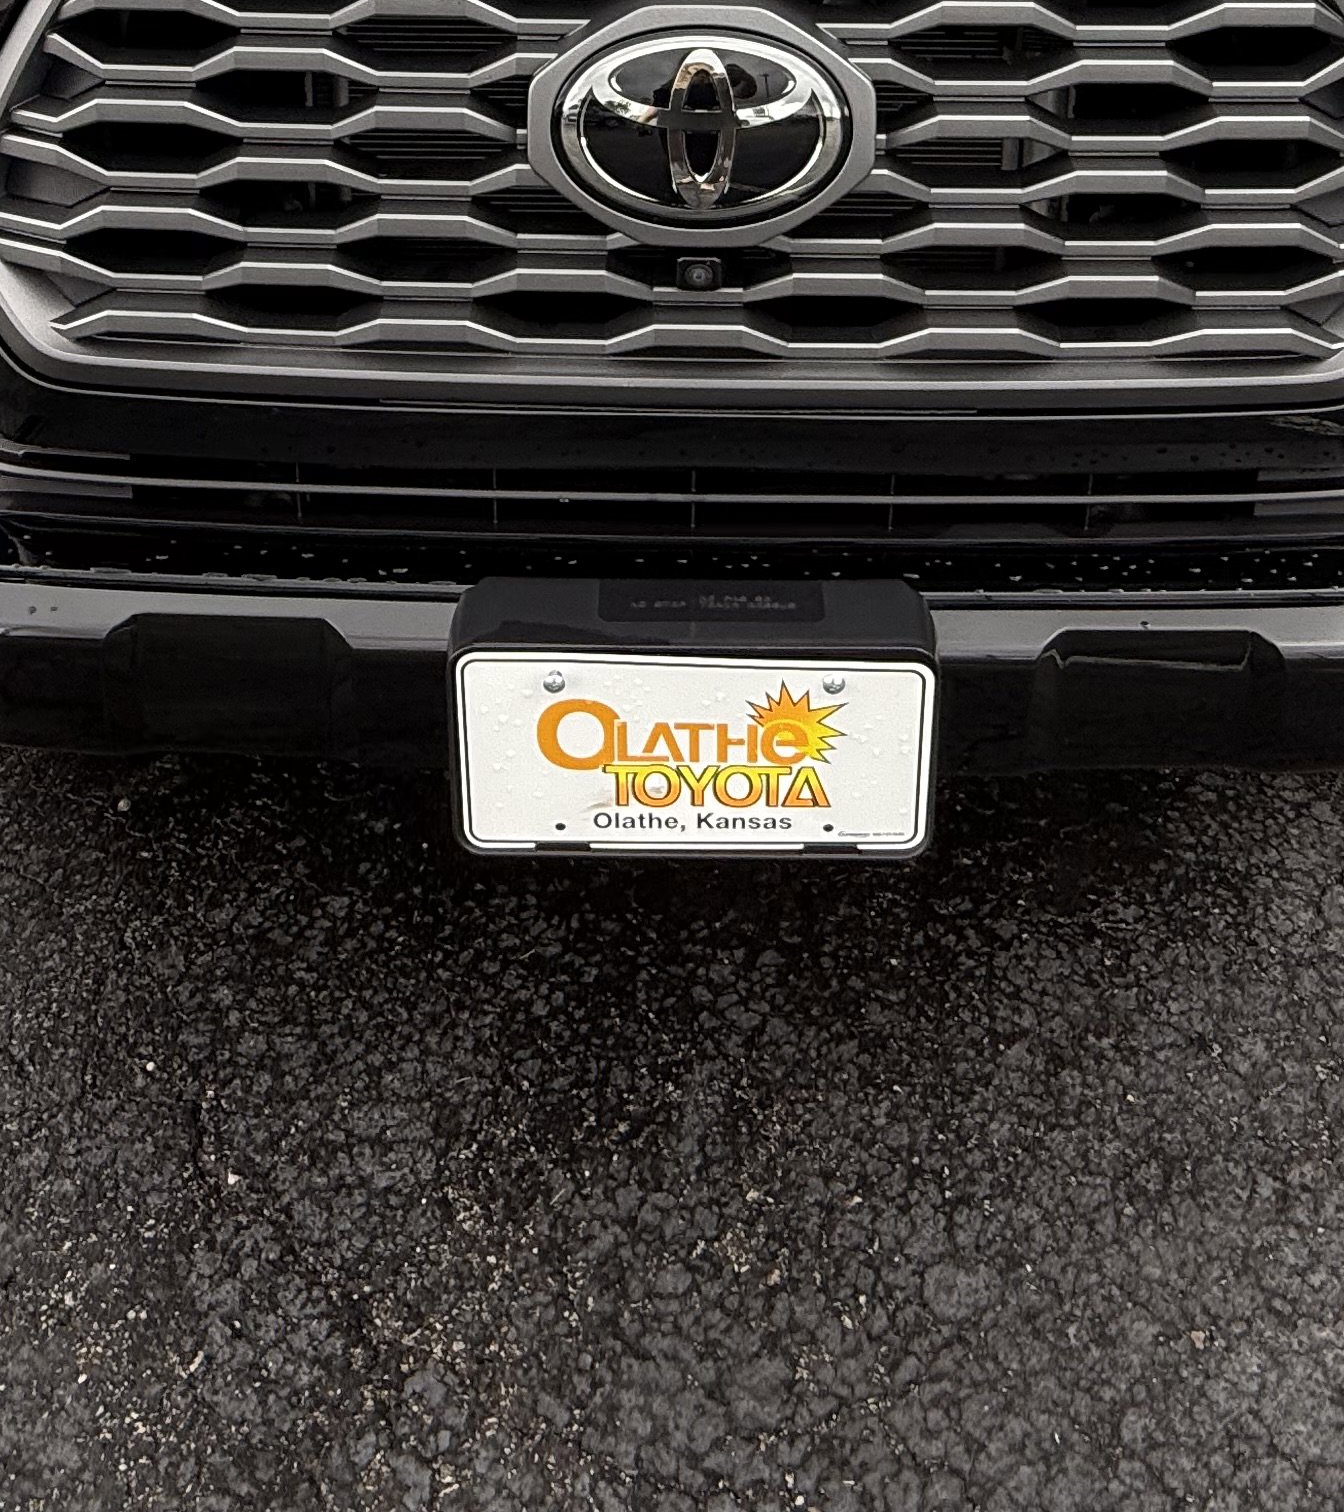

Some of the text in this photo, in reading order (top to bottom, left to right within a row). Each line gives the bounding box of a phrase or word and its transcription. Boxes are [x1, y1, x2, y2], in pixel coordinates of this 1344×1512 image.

[603, 765, 831, 808] TOYOTA
[593, 812, 792, 832] Olathe, Kansas
